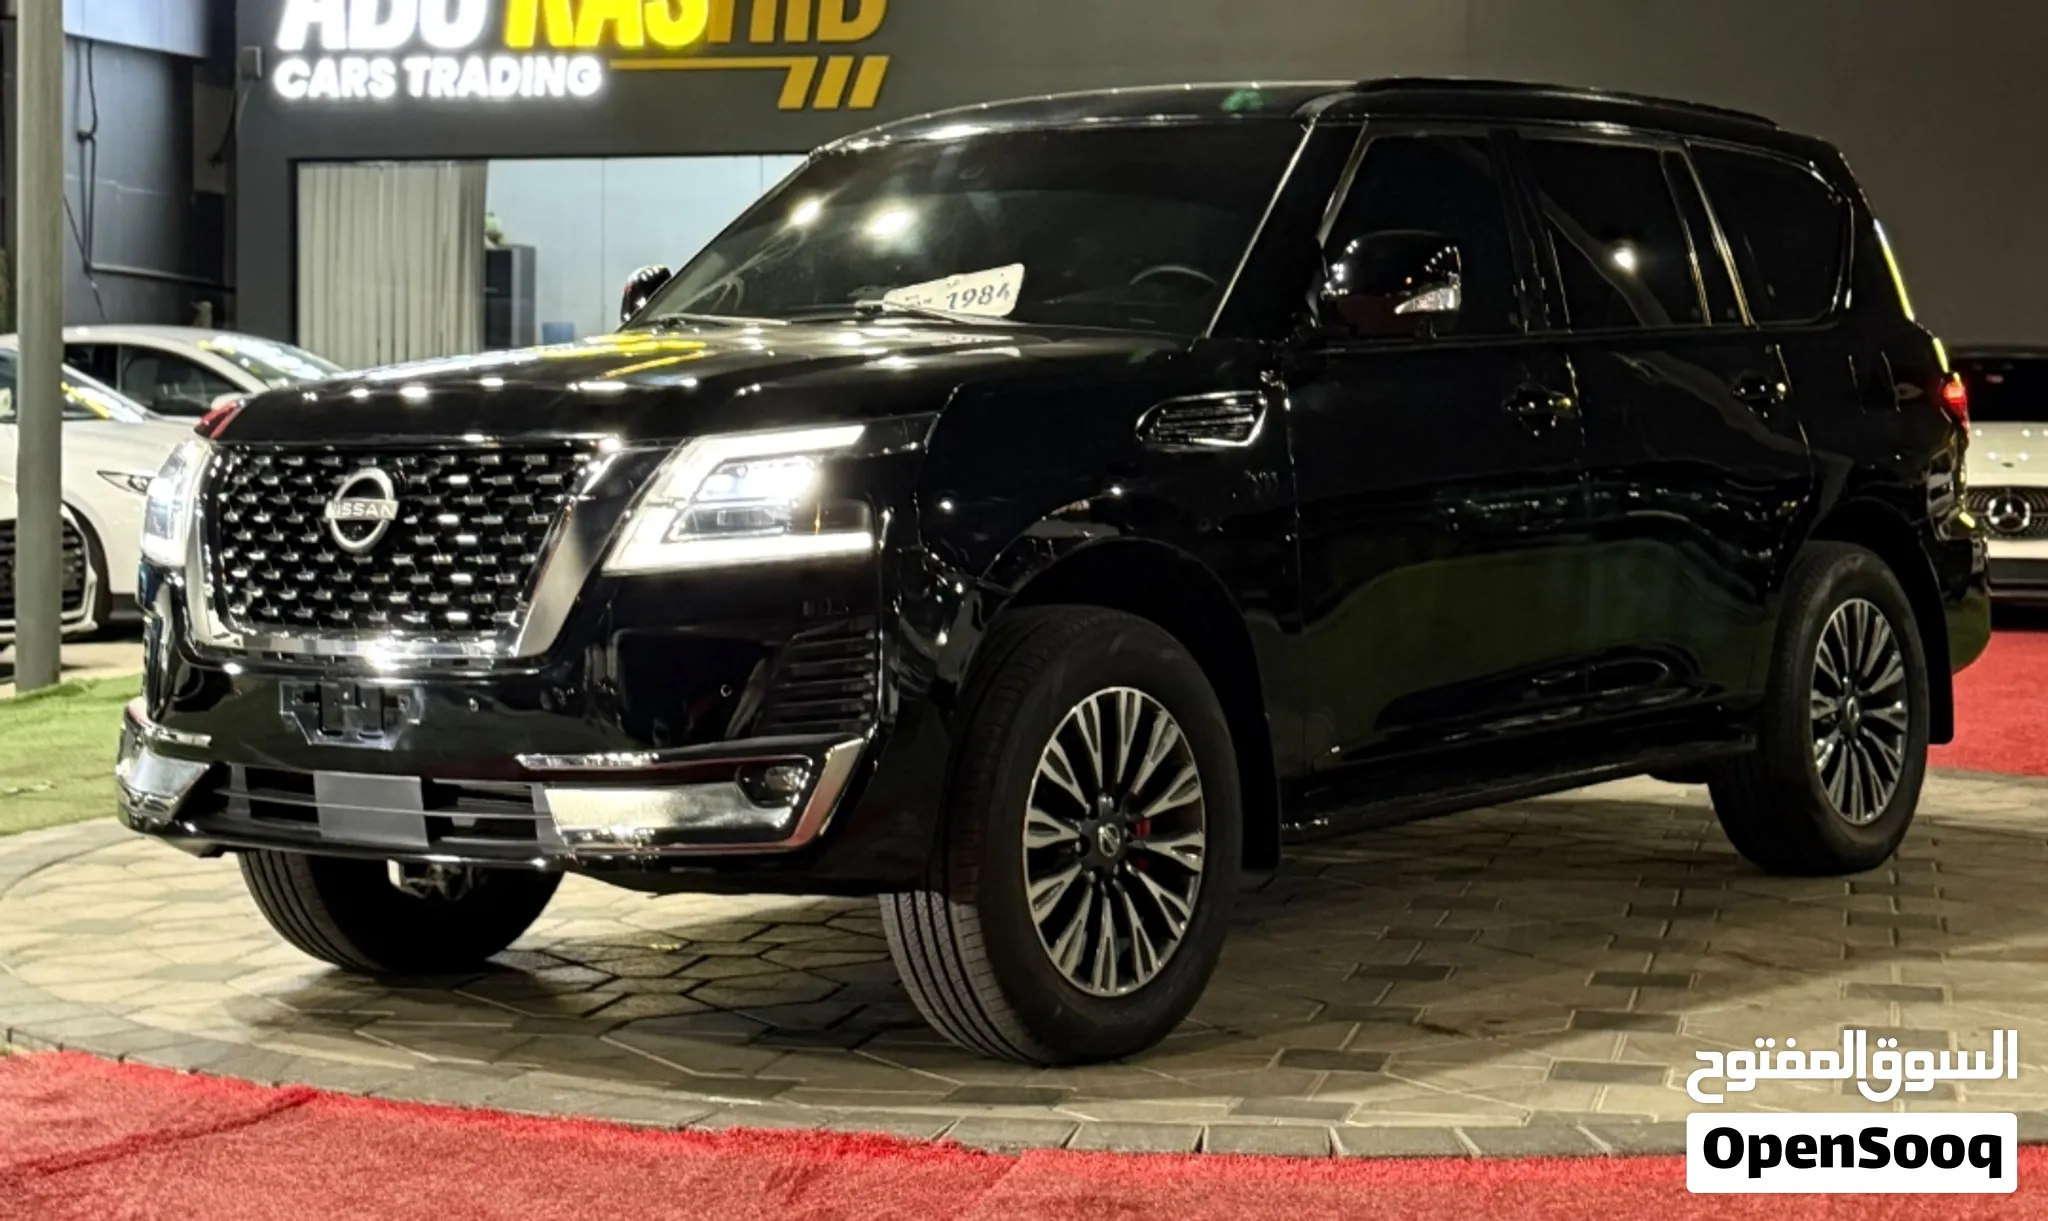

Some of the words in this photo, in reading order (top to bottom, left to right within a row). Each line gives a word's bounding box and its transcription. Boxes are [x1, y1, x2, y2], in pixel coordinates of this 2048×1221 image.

[274, 57, 397, 98] CARS
[402, 55, 602, 97] TRADING
[326, 501, 398, 519] NISSAN
